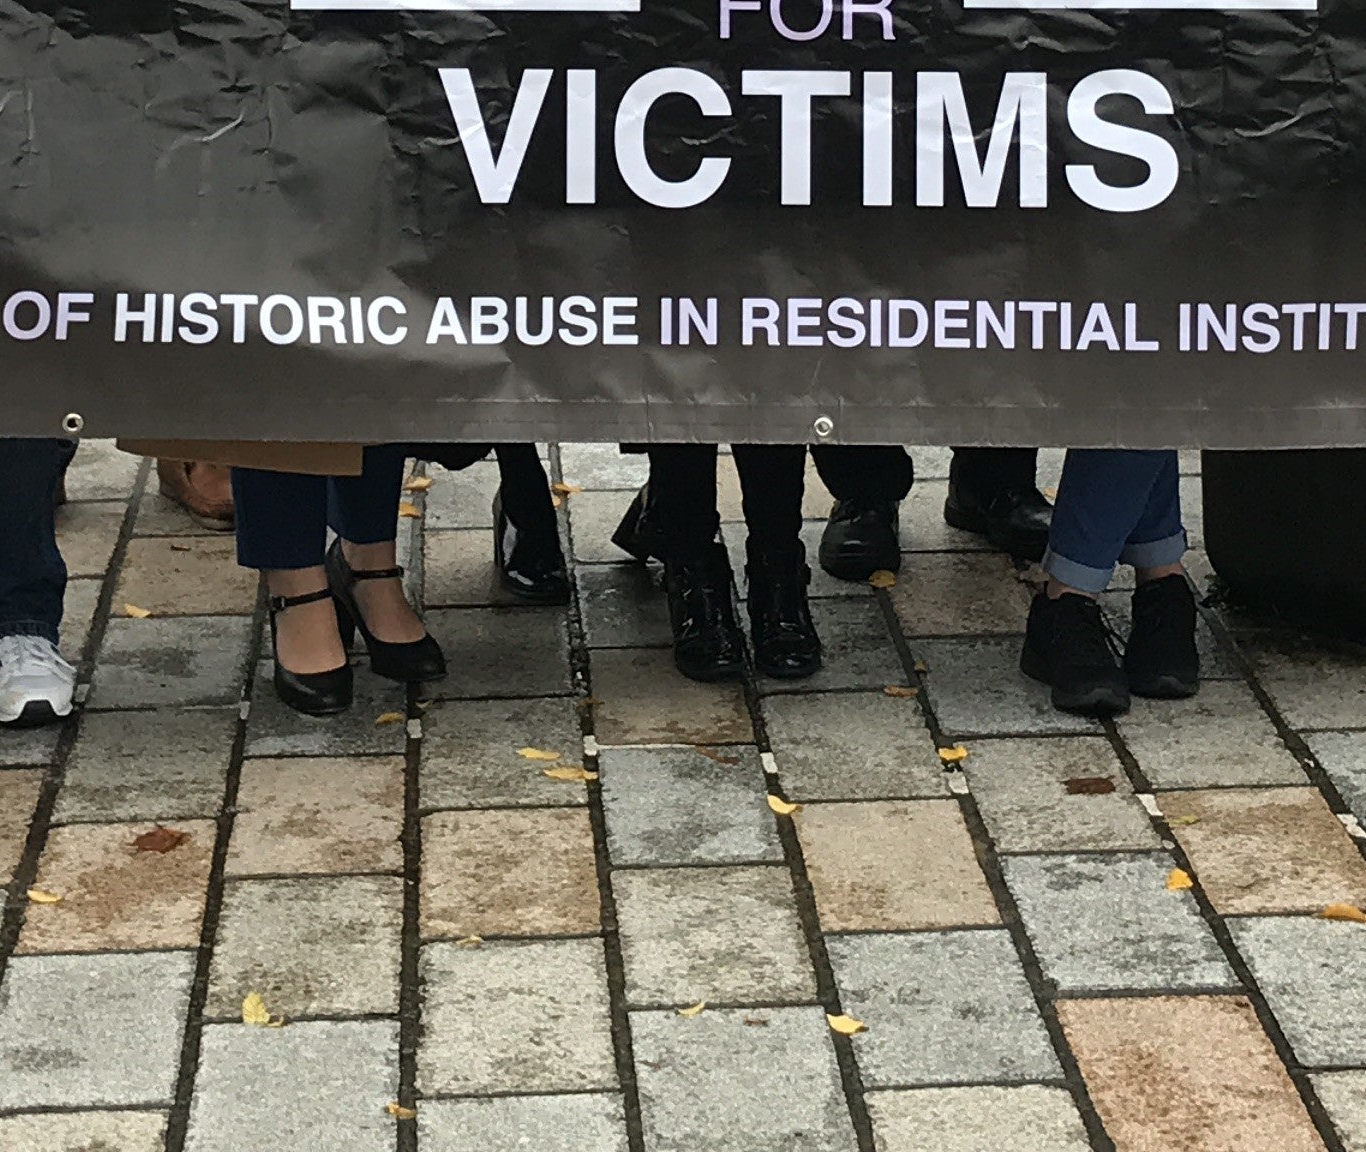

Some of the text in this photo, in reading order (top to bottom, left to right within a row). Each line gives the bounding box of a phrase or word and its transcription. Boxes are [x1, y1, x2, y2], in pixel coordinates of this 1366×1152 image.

[437, 67, 1179, 212] VICTIMS
[3, 291, 94, 340] OF
[114, 292, 408, 345] HISTORIC
[425, 295, 639, 346] ABUSE
[660, 297, 717, 345] IN
[742, 297, 1159, 351] RESIDENTIAL
